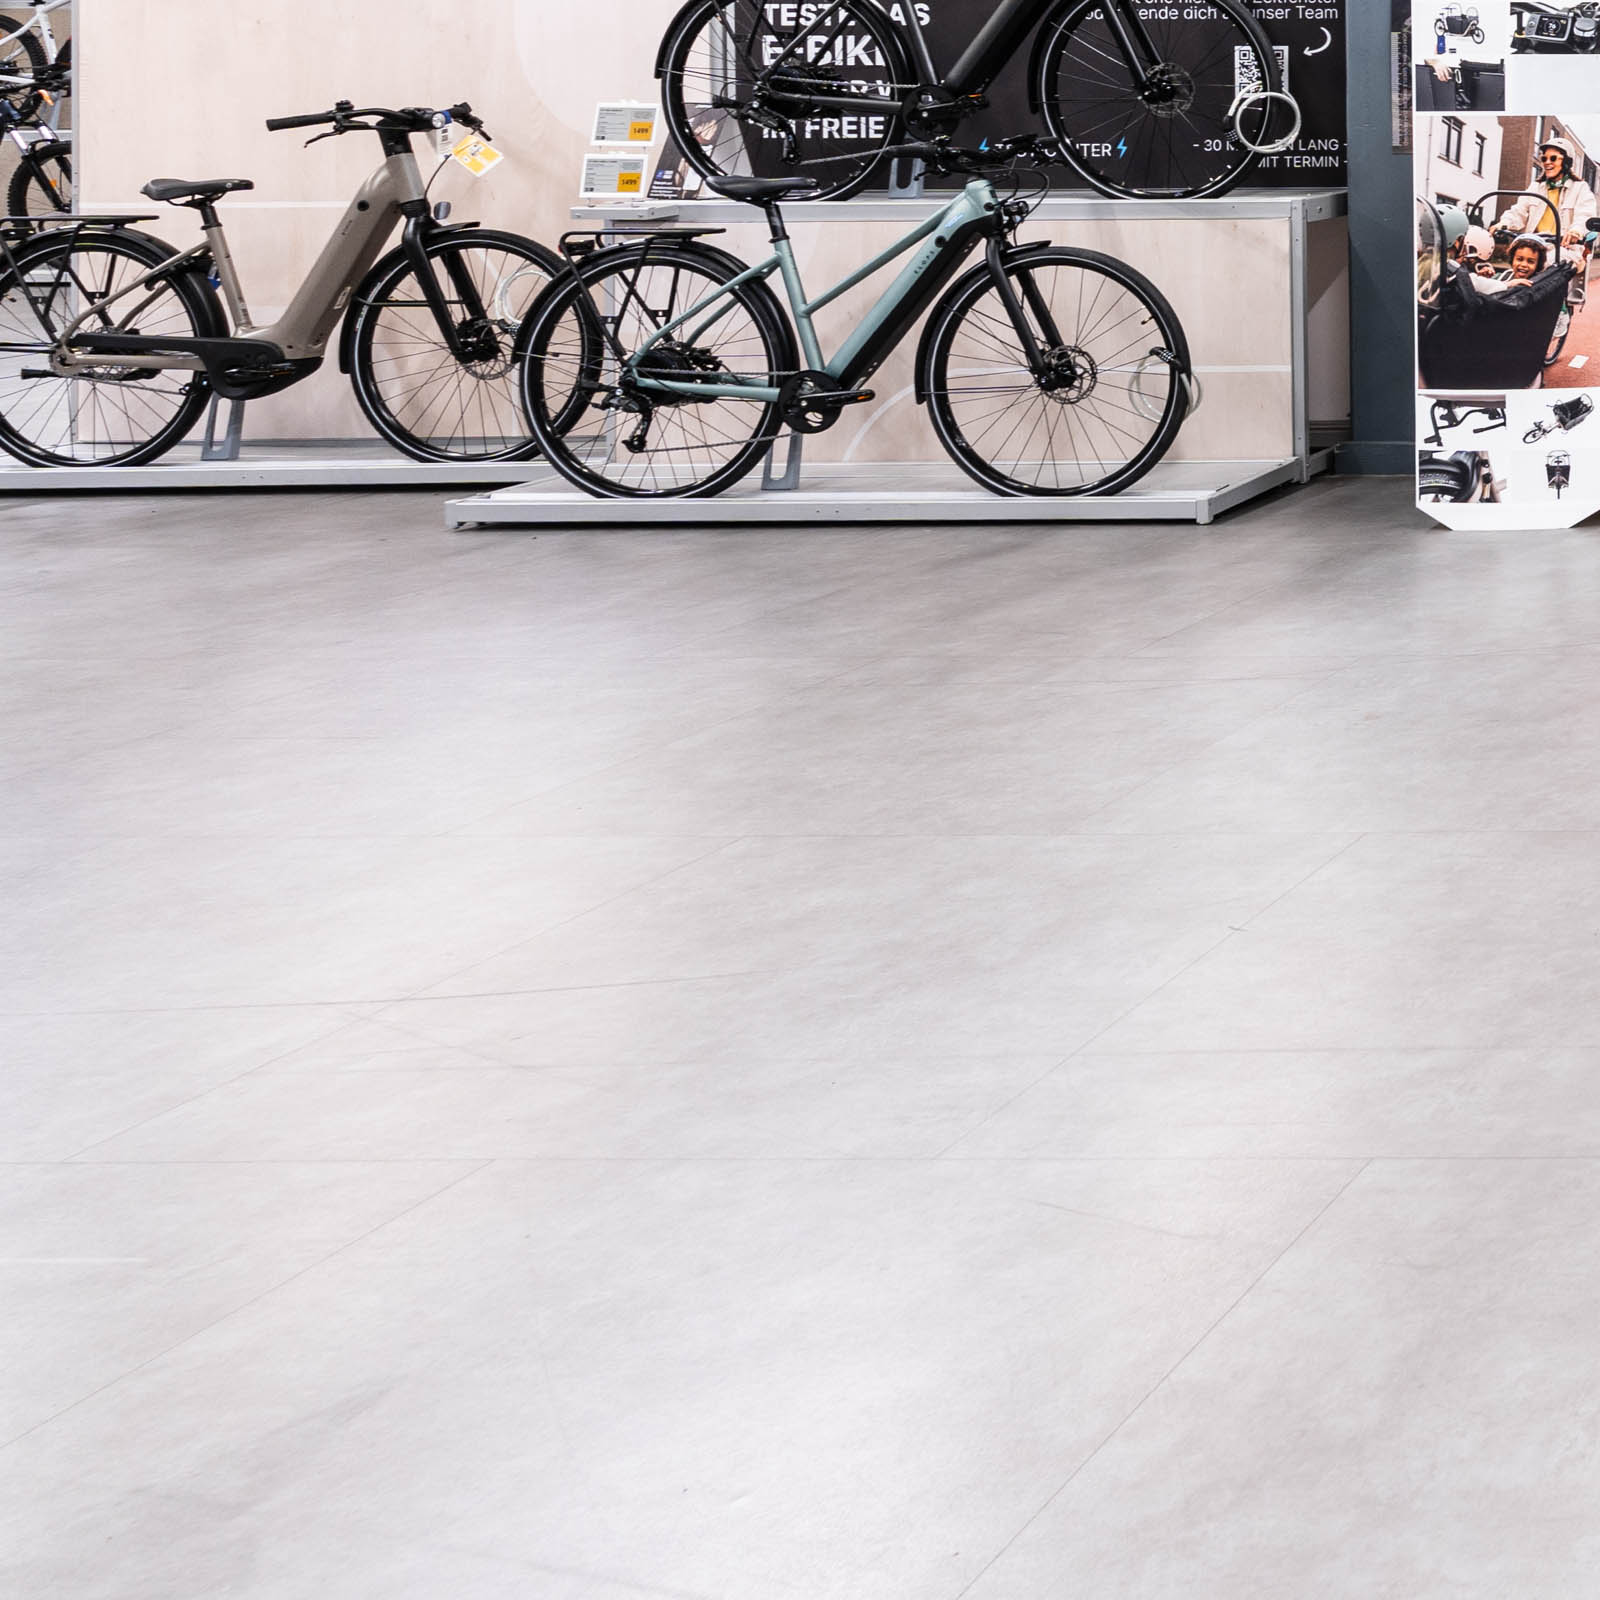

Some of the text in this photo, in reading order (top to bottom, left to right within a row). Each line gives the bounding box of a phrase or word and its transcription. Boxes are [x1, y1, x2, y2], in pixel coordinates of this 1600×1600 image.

[1138, 6, 1179, 20] ende
[1183, 6, 1218, 20] dich
[1295, 6, 1339, 20] Team
[633, 127, 649, 135] 1499
[805, 116, 888, 139] FREIE
[1203, 139, 1221, 152] 30
[1299, 138, 1339, 151] LANG
[1284, 156, 1339, 168] TERMIN
[621, 178, 638, 186] 1499
